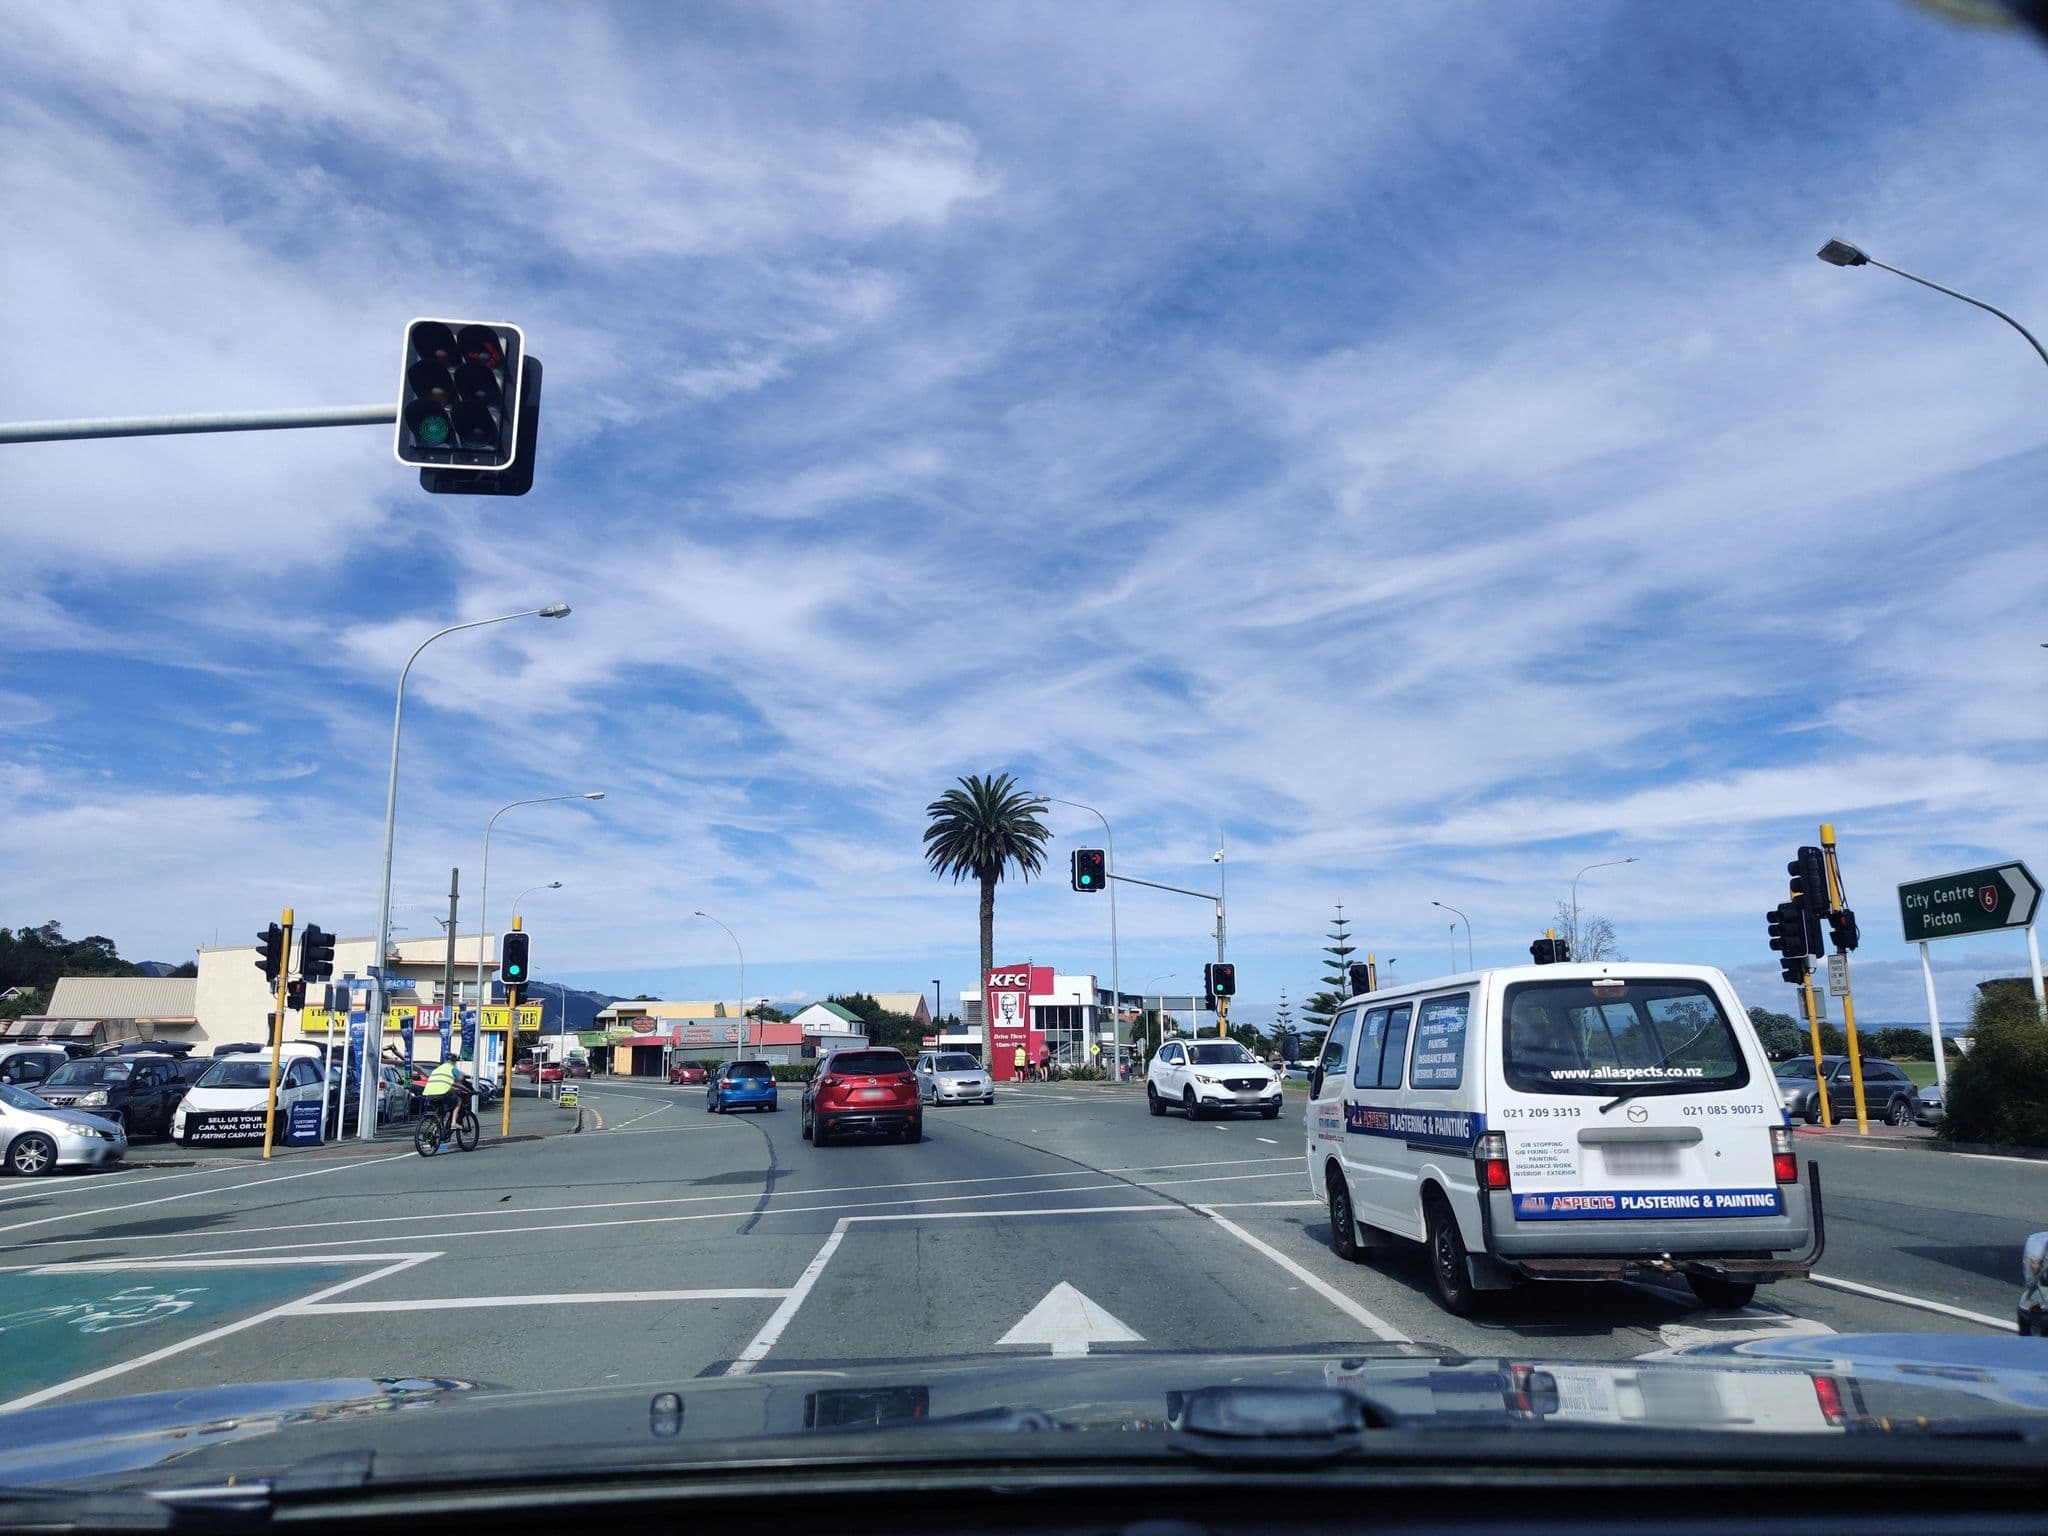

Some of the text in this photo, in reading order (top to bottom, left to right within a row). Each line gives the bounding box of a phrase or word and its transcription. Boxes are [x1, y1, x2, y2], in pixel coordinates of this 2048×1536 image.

[1906, 886, 1974, 909] City Centre
[1985, 892, 1993, 905] 6
[1923, 912, 1961, 928] Picton
[988, 974, 1027, 987] KFC
[1551, 1066, 1704, 1081] www.allaspects.co.nz
[1503, 1107, 1581, 1118] 021 209 3313
[1683, 1104, 1764, 1116] 021 085 90073
[1390, 1114, 1427, 1134] PLASTERING
[1428, 1116, 1433, 1134] &
[1435, 1117, 1470, 1139] PAINTING
[1552, 1196, 1616, 1210] ASPECTS
[1621, 1196, 1700, 1209] PLASTERING
[1703, 1195, 1713, 1208] &
[1716, 1194, 1775, 1208] PAINTING
